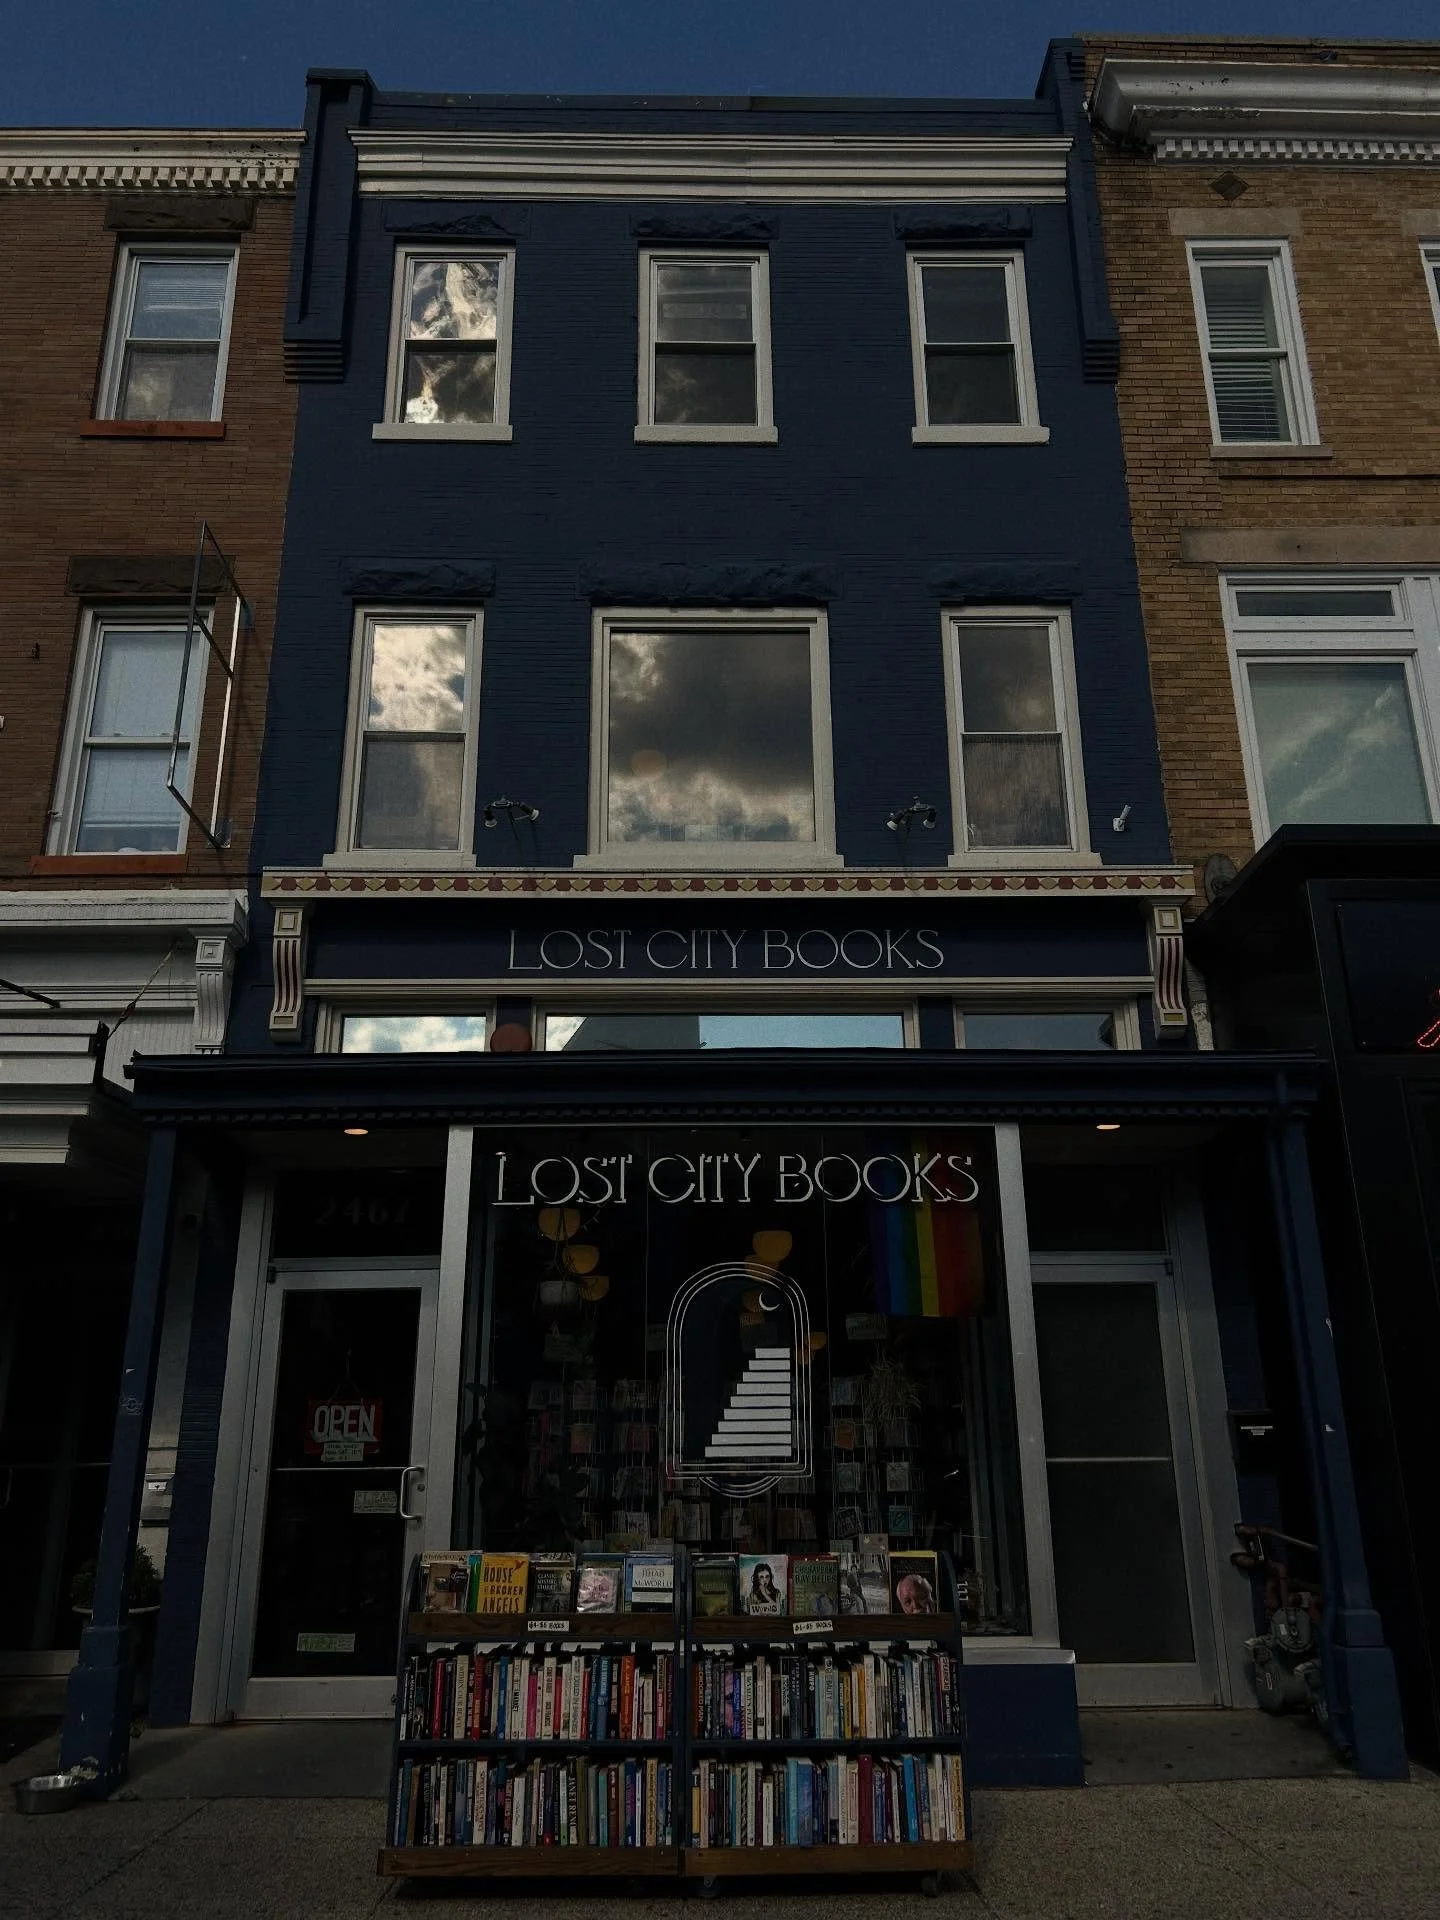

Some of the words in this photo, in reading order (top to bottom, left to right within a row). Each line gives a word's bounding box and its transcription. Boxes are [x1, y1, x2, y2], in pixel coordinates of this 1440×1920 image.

[508, 928, 632, 971] LOST
[646, 928, 748, 970] CITY
[762, 928, 945, 970] BOOKS
[491, 1151, 633, 1206] LOST
[647, 1152, 761, 1205] CITY
[773, 1152, 980, 1205] BOOKS
[313, 1404, 376, 1442] OPEN
[483, 1565, 514, 1584] HOUSE
[490, 1585, 524, 1596] BROKEN
[482, 1597, 520, 1614] ANGELS
[568, 1775, 577, 1803] JANET
[567, 1804, 576, 1828] RENO
